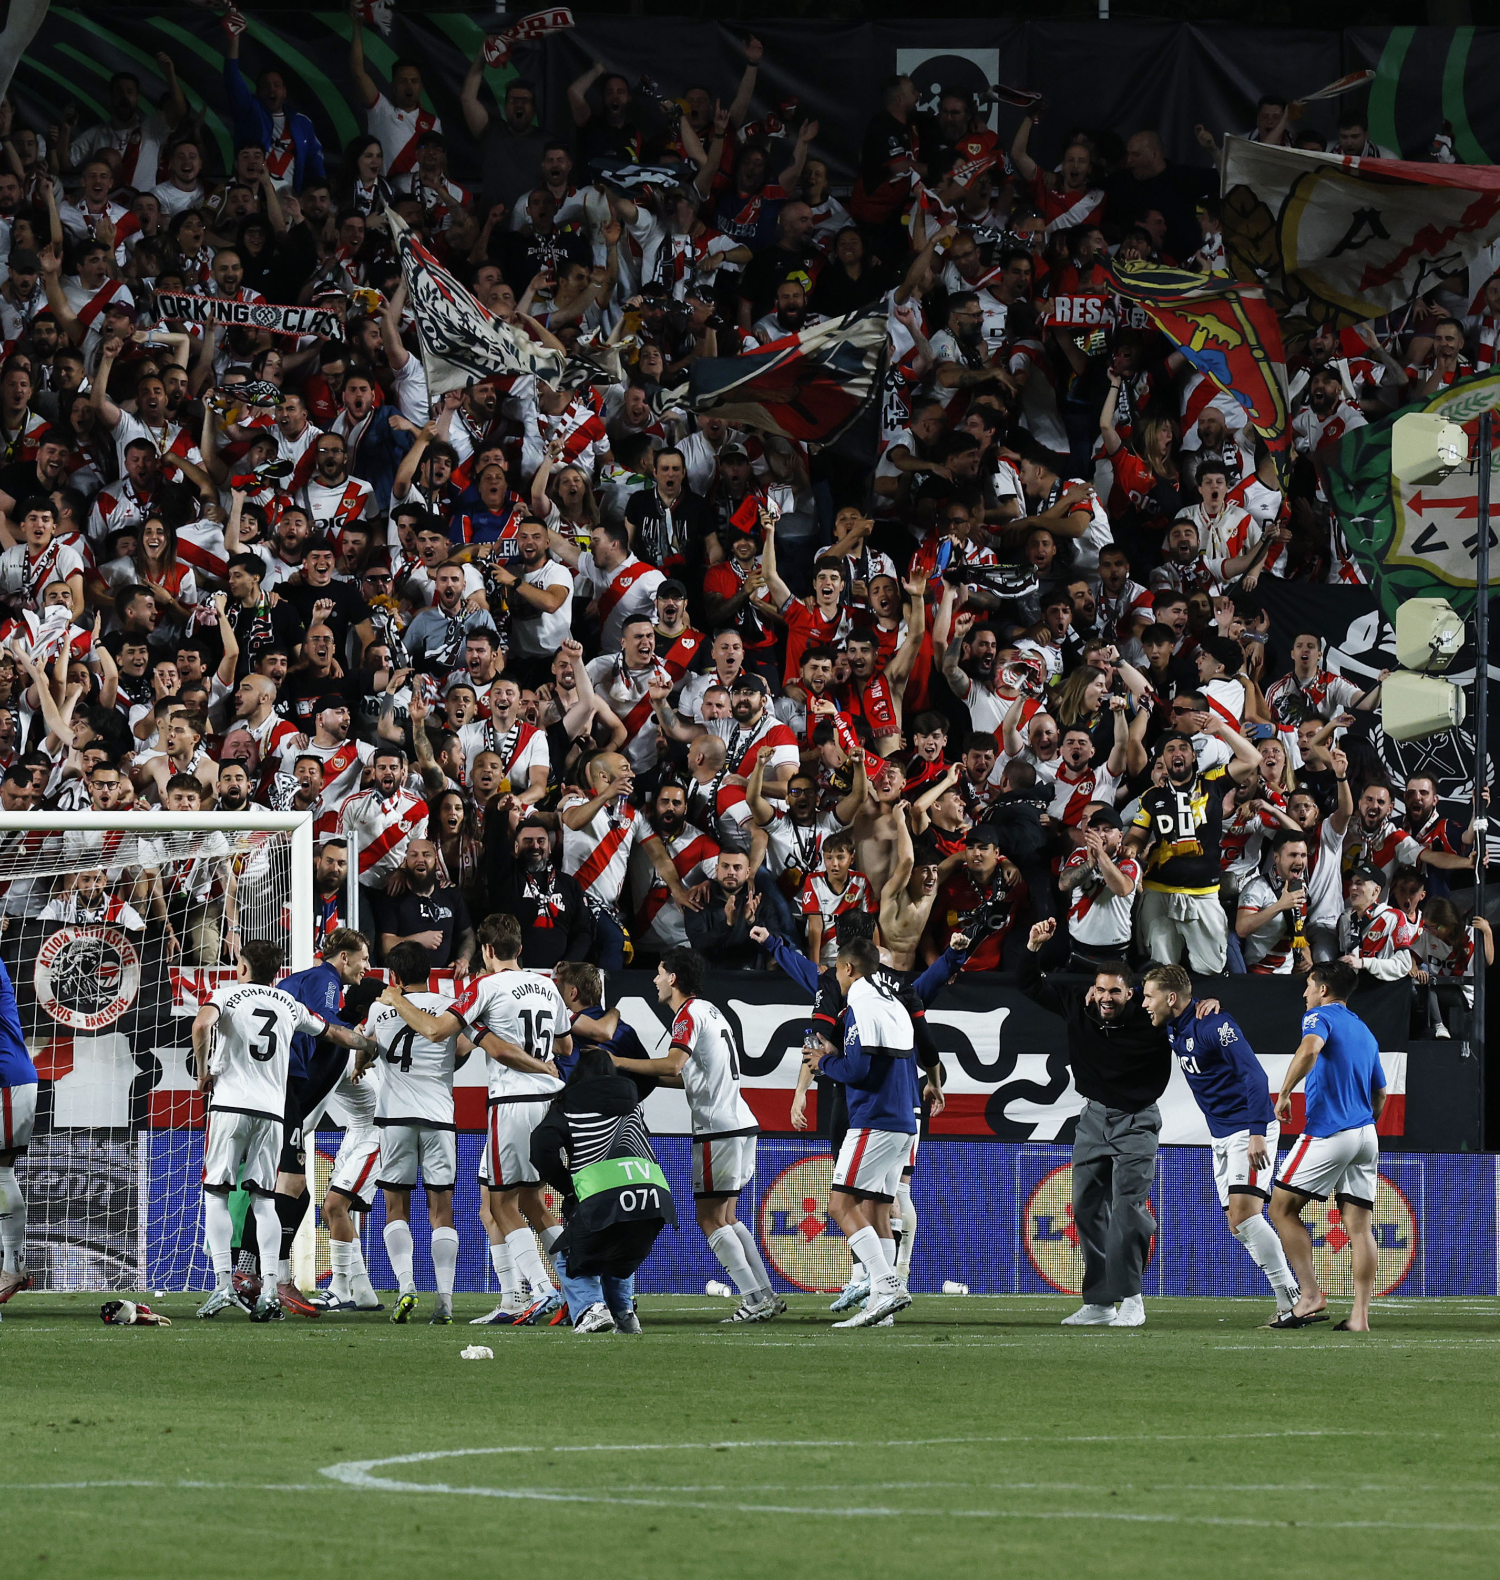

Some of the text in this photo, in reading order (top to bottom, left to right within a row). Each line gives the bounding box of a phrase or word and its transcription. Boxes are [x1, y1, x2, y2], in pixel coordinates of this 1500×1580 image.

[40, 931, 71, 969] ACTION
[226, 986, 298, 1022] PEPCHAVARRIA
[511, 984, 554, 1002] GUMBAU
[249, 1008, 278, 1062] 3
[384, 1024, 413, 1073] 4
[517, 1009, 553, 1063] 15
[617, 1161, 651, 1181] TV
[619, 1188, 661, 1213] 071
